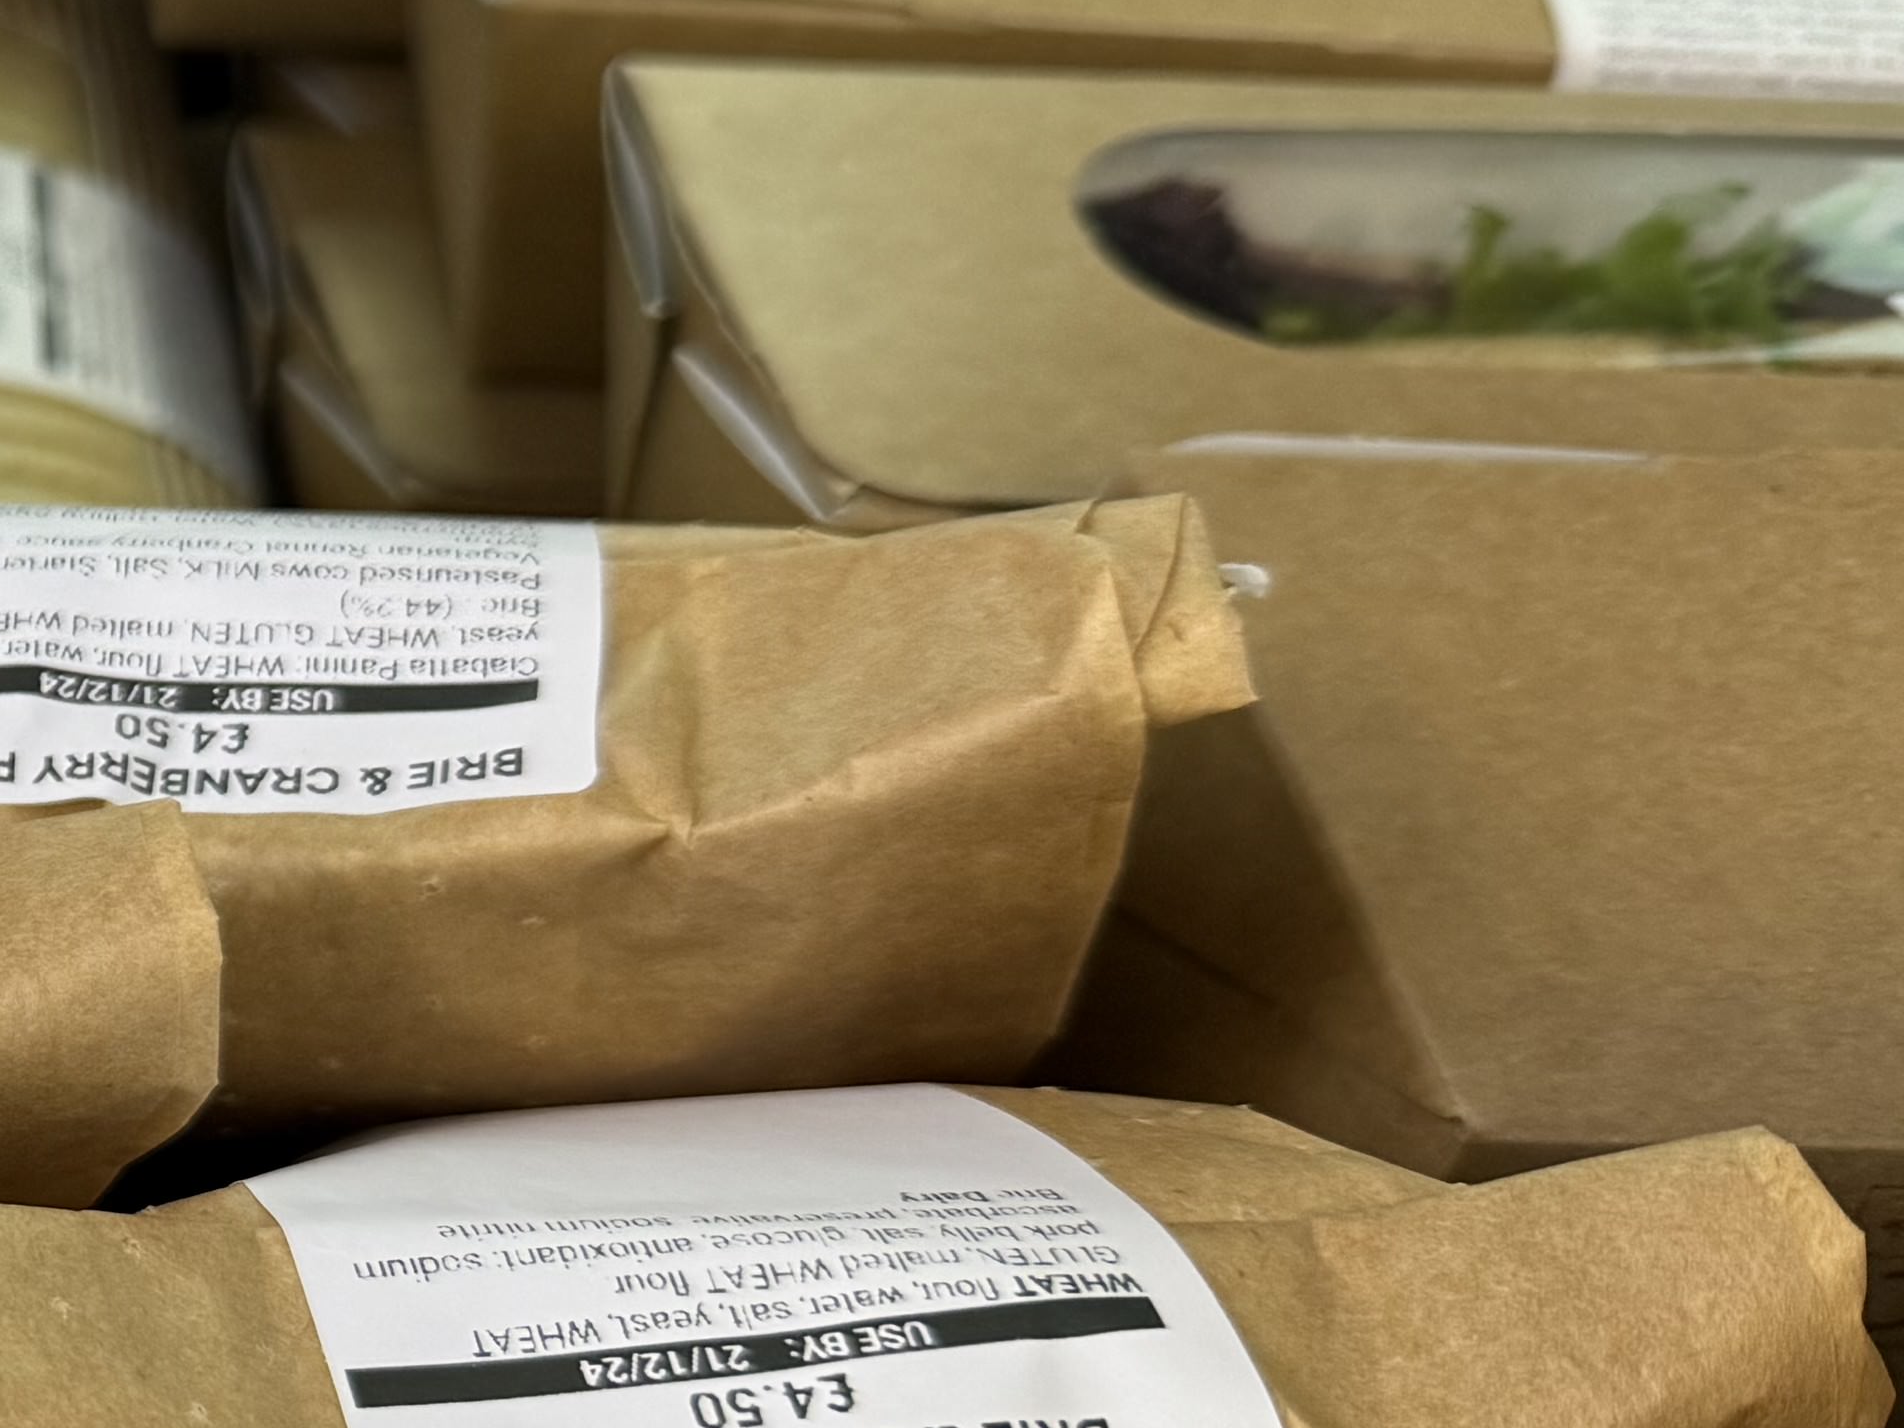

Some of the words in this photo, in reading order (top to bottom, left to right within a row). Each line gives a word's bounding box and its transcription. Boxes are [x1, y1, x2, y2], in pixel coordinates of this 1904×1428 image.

[40, 673, 178, 708] 21/12/24
[211, 687, 264, 711] BY:
[269, 687, 336, 712] USE
[115, 713, 250, 755] £4.50
[35, 754, 339, 796] CRANBERRY
[359, 766, 393, 796] &
[408, 747, 524, 790] BRIE
[785, 1328, 846, 1361] BY:
[851, 1319, 932, 1356] USE
[578, 1344, 750, 1386] 21/12/24
